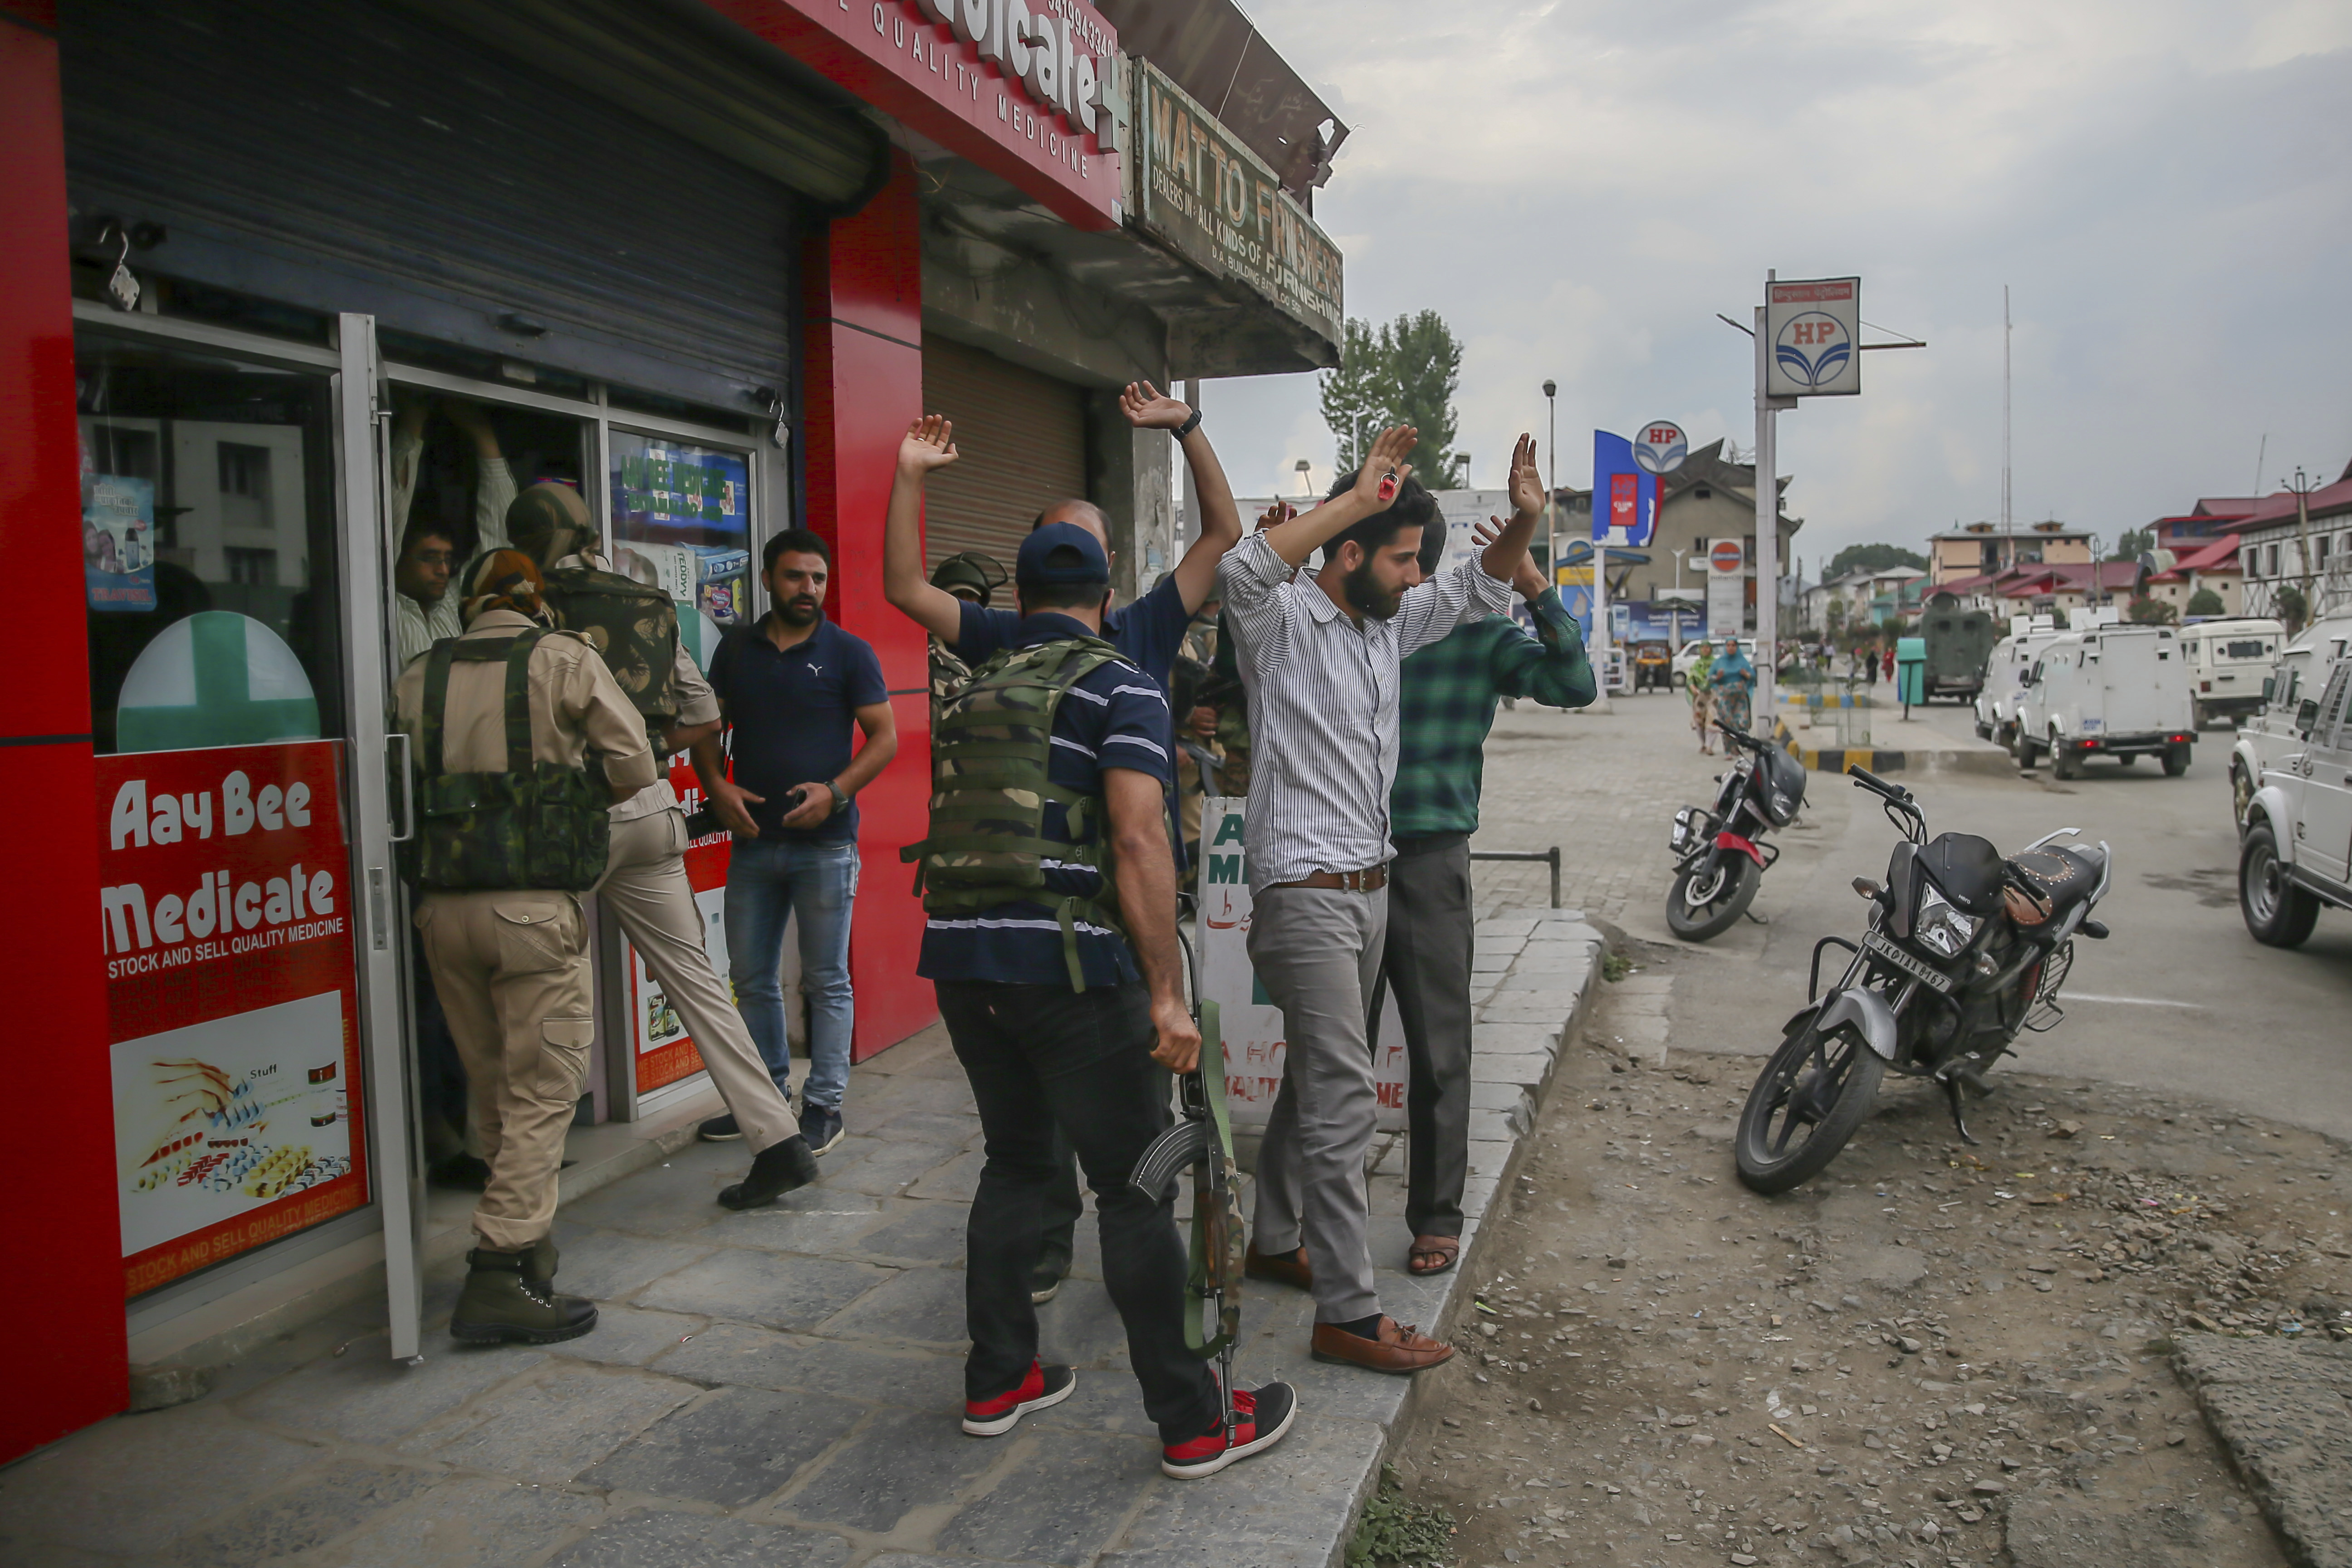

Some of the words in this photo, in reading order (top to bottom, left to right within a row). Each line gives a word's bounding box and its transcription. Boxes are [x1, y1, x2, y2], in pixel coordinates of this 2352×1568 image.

[873, 3, 978, 100] QUALITY
[998, 93, 1088, 179] MEDICINE
[1151, 85, 1247, 227] MATTO
[1153, 165, 1184, 212] DEALERS
[1198, 205, 1214, 236] ALL
[1216, 217, 1246, 258] KINDS
[1249, 240, 1261, 265] OF
[1228, 255, 1259, 285] BUILDING
[1793, 322, 1835, 345] HP
[1649, 428, 1677, 444] HP
[110, 779, 212, 850] Aay
[222, 770, 311, 836] Bee
[101, 863, 333, 956] Medicate
[1958, 894, 1971, 904] Hero
[108, 953, 159, 979] STOCK
[162, 947, 191, 968] AND
[195, 940, 229, 962] SELL
[232, 928, 285, 953] QUALITY
[288, 917, 343, 942] MEDICINE
[250, 1063, 278, 1079] Stuff
[127, 1254, 177, 1287] STOCK
[181, 1241, 209, 1266] AND
[213, 1228, 245, 1254] SELL
[249, 1205, 301, 1239] QUALITY
